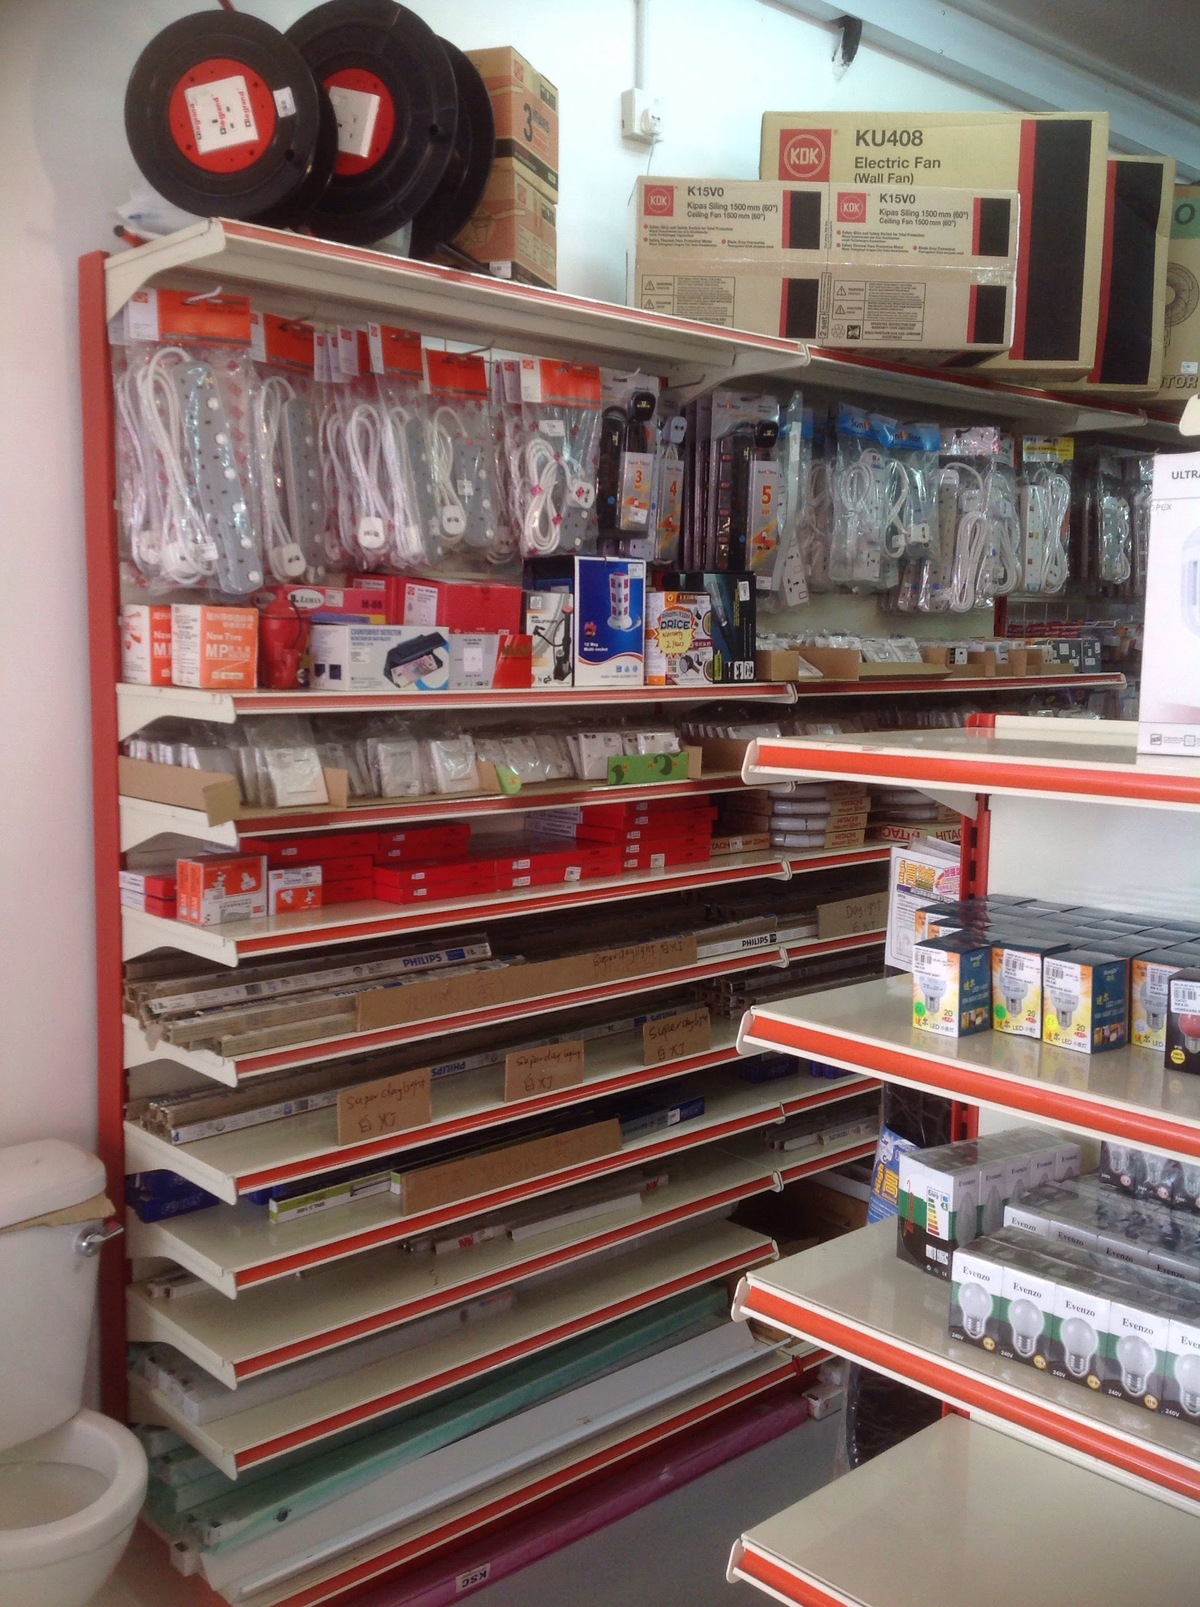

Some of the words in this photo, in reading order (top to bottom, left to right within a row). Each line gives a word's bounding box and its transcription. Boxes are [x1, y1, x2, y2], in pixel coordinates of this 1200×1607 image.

[523, 102, 534, 142] 3
[855, 129, 924, 147] KU408
[790, 147, 819, 165] KDK
[853, 156, 911, 170] Electric
[914, 156, 942, 169] Fan
[853, 172, 885, 185] (Wall
[887, 173, 915, 186] Fan)
[687, 186, 725, 198] K15V0
[879, 193, 916, 204] K15V0
[649, 195, 668, 206] KDK
[687, 202, 708, 211] Kipas
[708, 202, 729, 212] Siling
[843, 202, 860, 213] KDK
[879, 209, 899, 218] Kipas
[900, 209, 921, 219] Siling
[687, 211, 709, 219] Ceiling
[879, 218, 901, 226] Ceiling
[902, 218, 914, 226] Fan
[635, 470, 642, 484] 3
[669, 480, 678, 496] 4
[761, 485, 772, 505] 5
[660, 619, 691, 630] PRICE
[741, 935, 769, 948] PHILIPS
[402, 953, 443, 968] PHILIPS
[943, 1009, 953, 1017] 20
[1027, 1009, 1036, 1018] 20
[1076, 1024, 1086, 1032] 20
[1152, 1040, 1164, 1048] LED
[431, 1061, 466, 1078] PHILIPS
[1011, 1217, 1037, 1231] Evenzo
[1057, 1231, 1084, 1246] Evenzo
[1106, 1247, 1134, 1262] Evenzo
[963, 1265, 990, 1282] Evenzo
[1157, 1264, 1185, 1279] Evenzo
[1013, 1282, 1042, 1298] Evenzo
[1065, 1300, 1096, 1317] Evenzo
[1122, 1317, 1154, 1335] Evenzo
[951, 1331, 964, 1340] 240V
[1001, 1349, 1014, 1358] 240V
[1052, 1369, 1066, 1378] 240V
[1108, 1388, 1122, 1397] 240V
[1165, 1407, 1180, 1417] 240V
[462, 1570, 487, 1588] KSC
